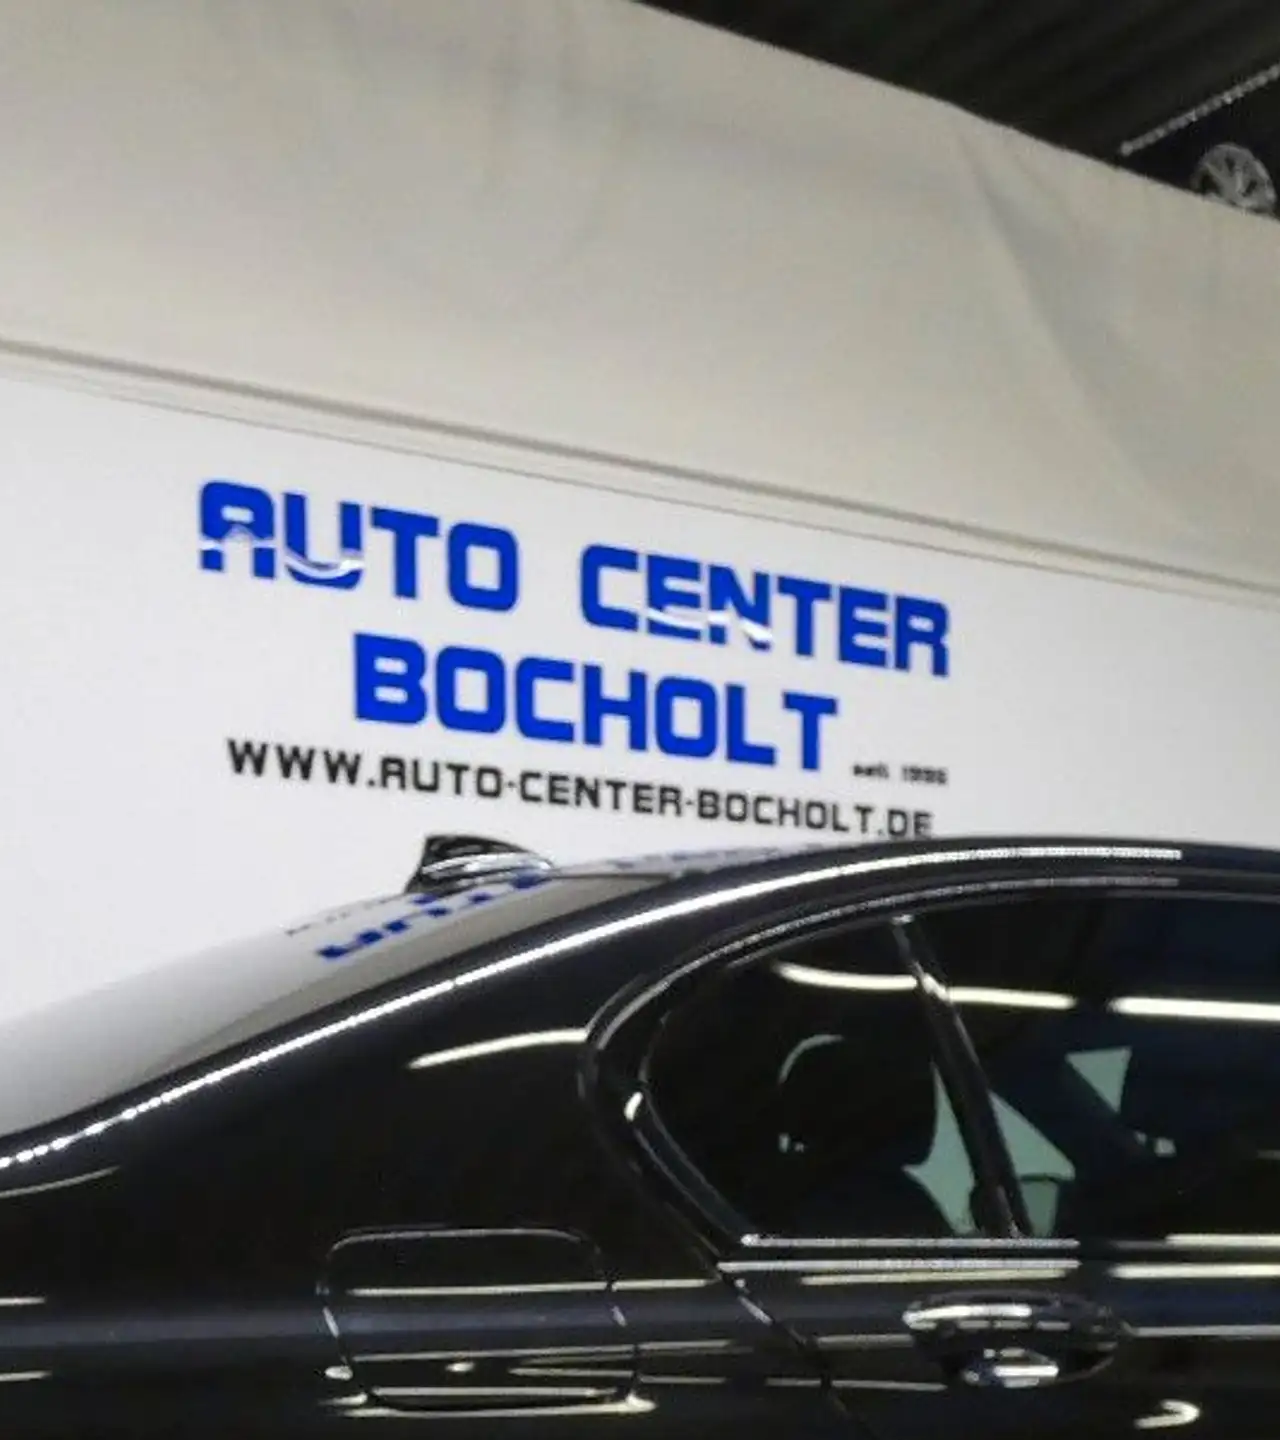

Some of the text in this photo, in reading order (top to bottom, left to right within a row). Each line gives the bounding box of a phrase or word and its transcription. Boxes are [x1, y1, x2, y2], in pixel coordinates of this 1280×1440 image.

[198, 479, 951, 678] AUTO CENTER
[352, 632, 839, 771] BOCHOLT
[227, 738, 934, 840] WWW.AUTO-CENTER-BOCHOLT.DE
